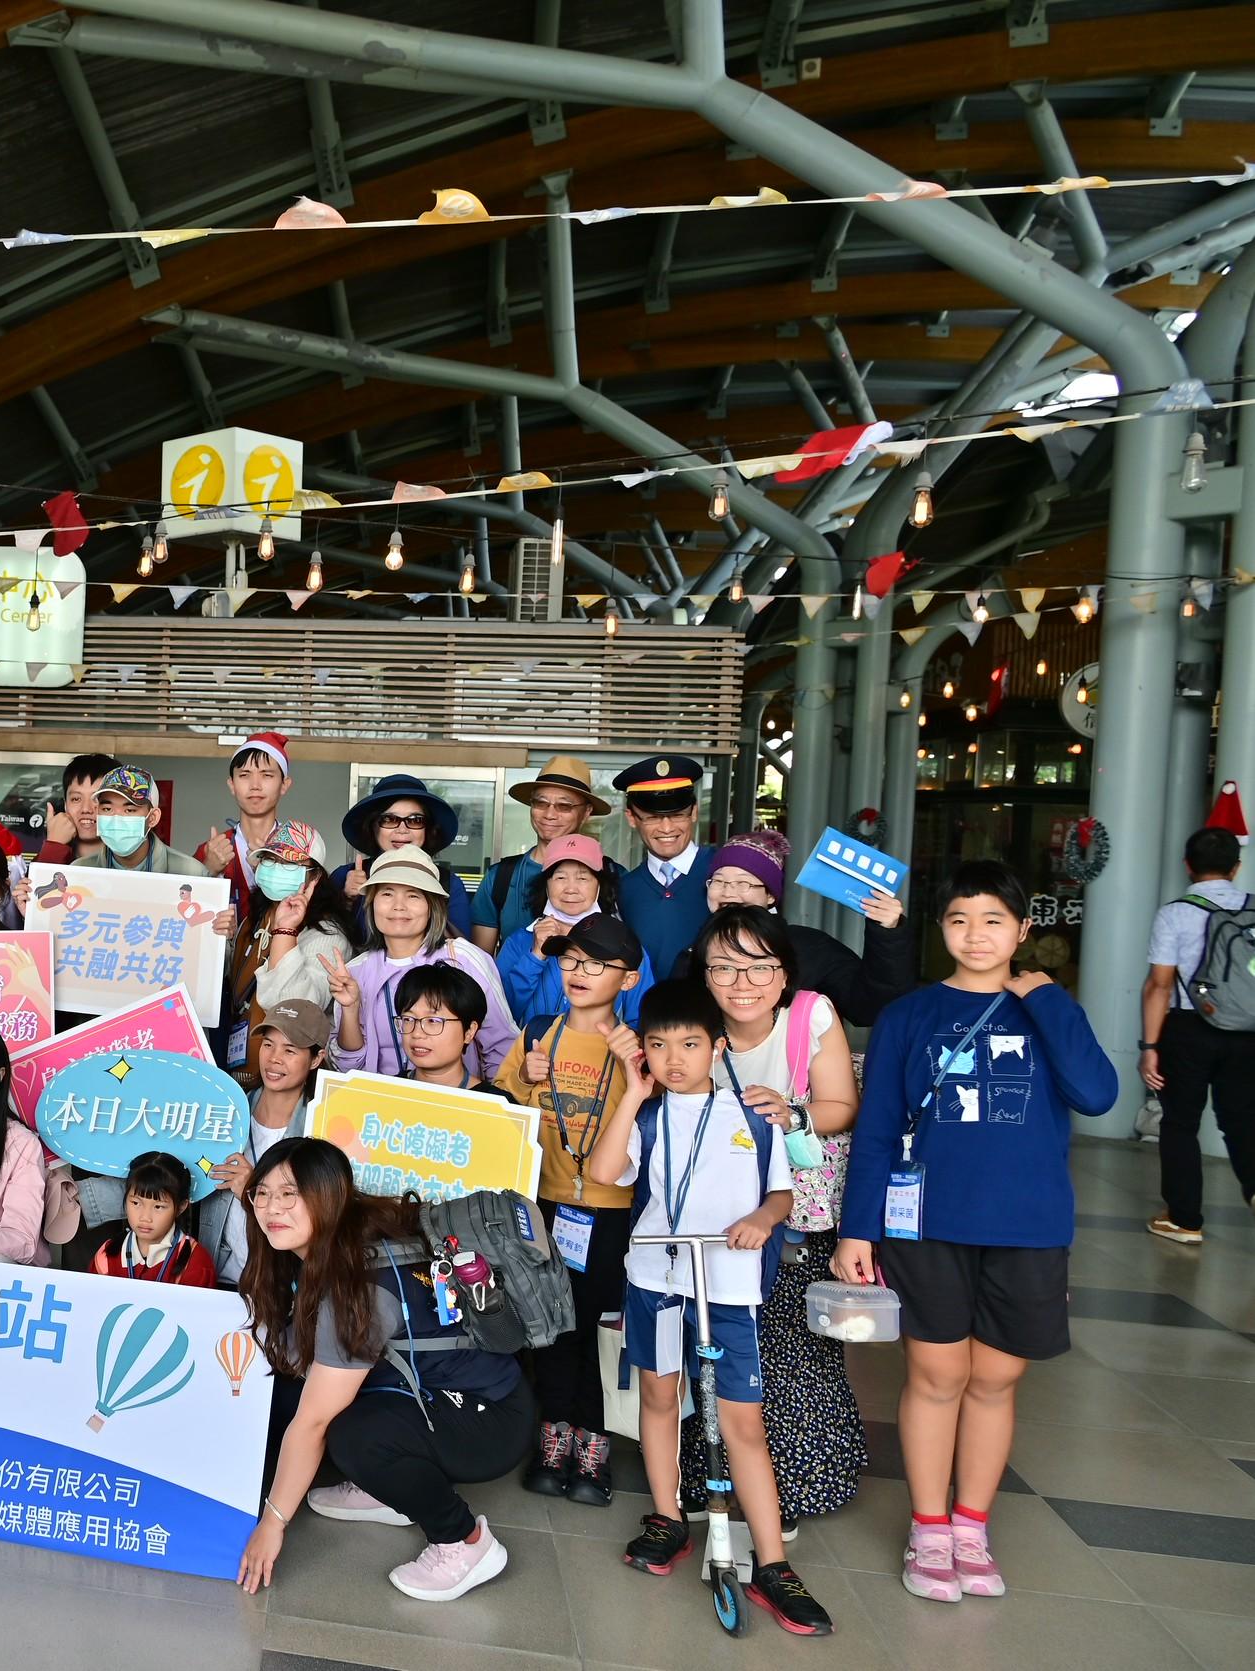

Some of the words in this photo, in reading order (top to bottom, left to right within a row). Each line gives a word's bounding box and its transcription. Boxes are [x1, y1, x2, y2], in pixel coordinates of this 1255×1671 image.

[1, 608, 53, 623] Cener
[0, 815, 25, 823] Taiwan
[57, 909, 187, 951] 多元參與
[54, 944, 184, 987] 共融共好
[953, 1022, 1008, 1034] Coction
[48, 1091, 236, 1143] 本日大明星
[361, 1112, 472, 1168] 身心障礙者
